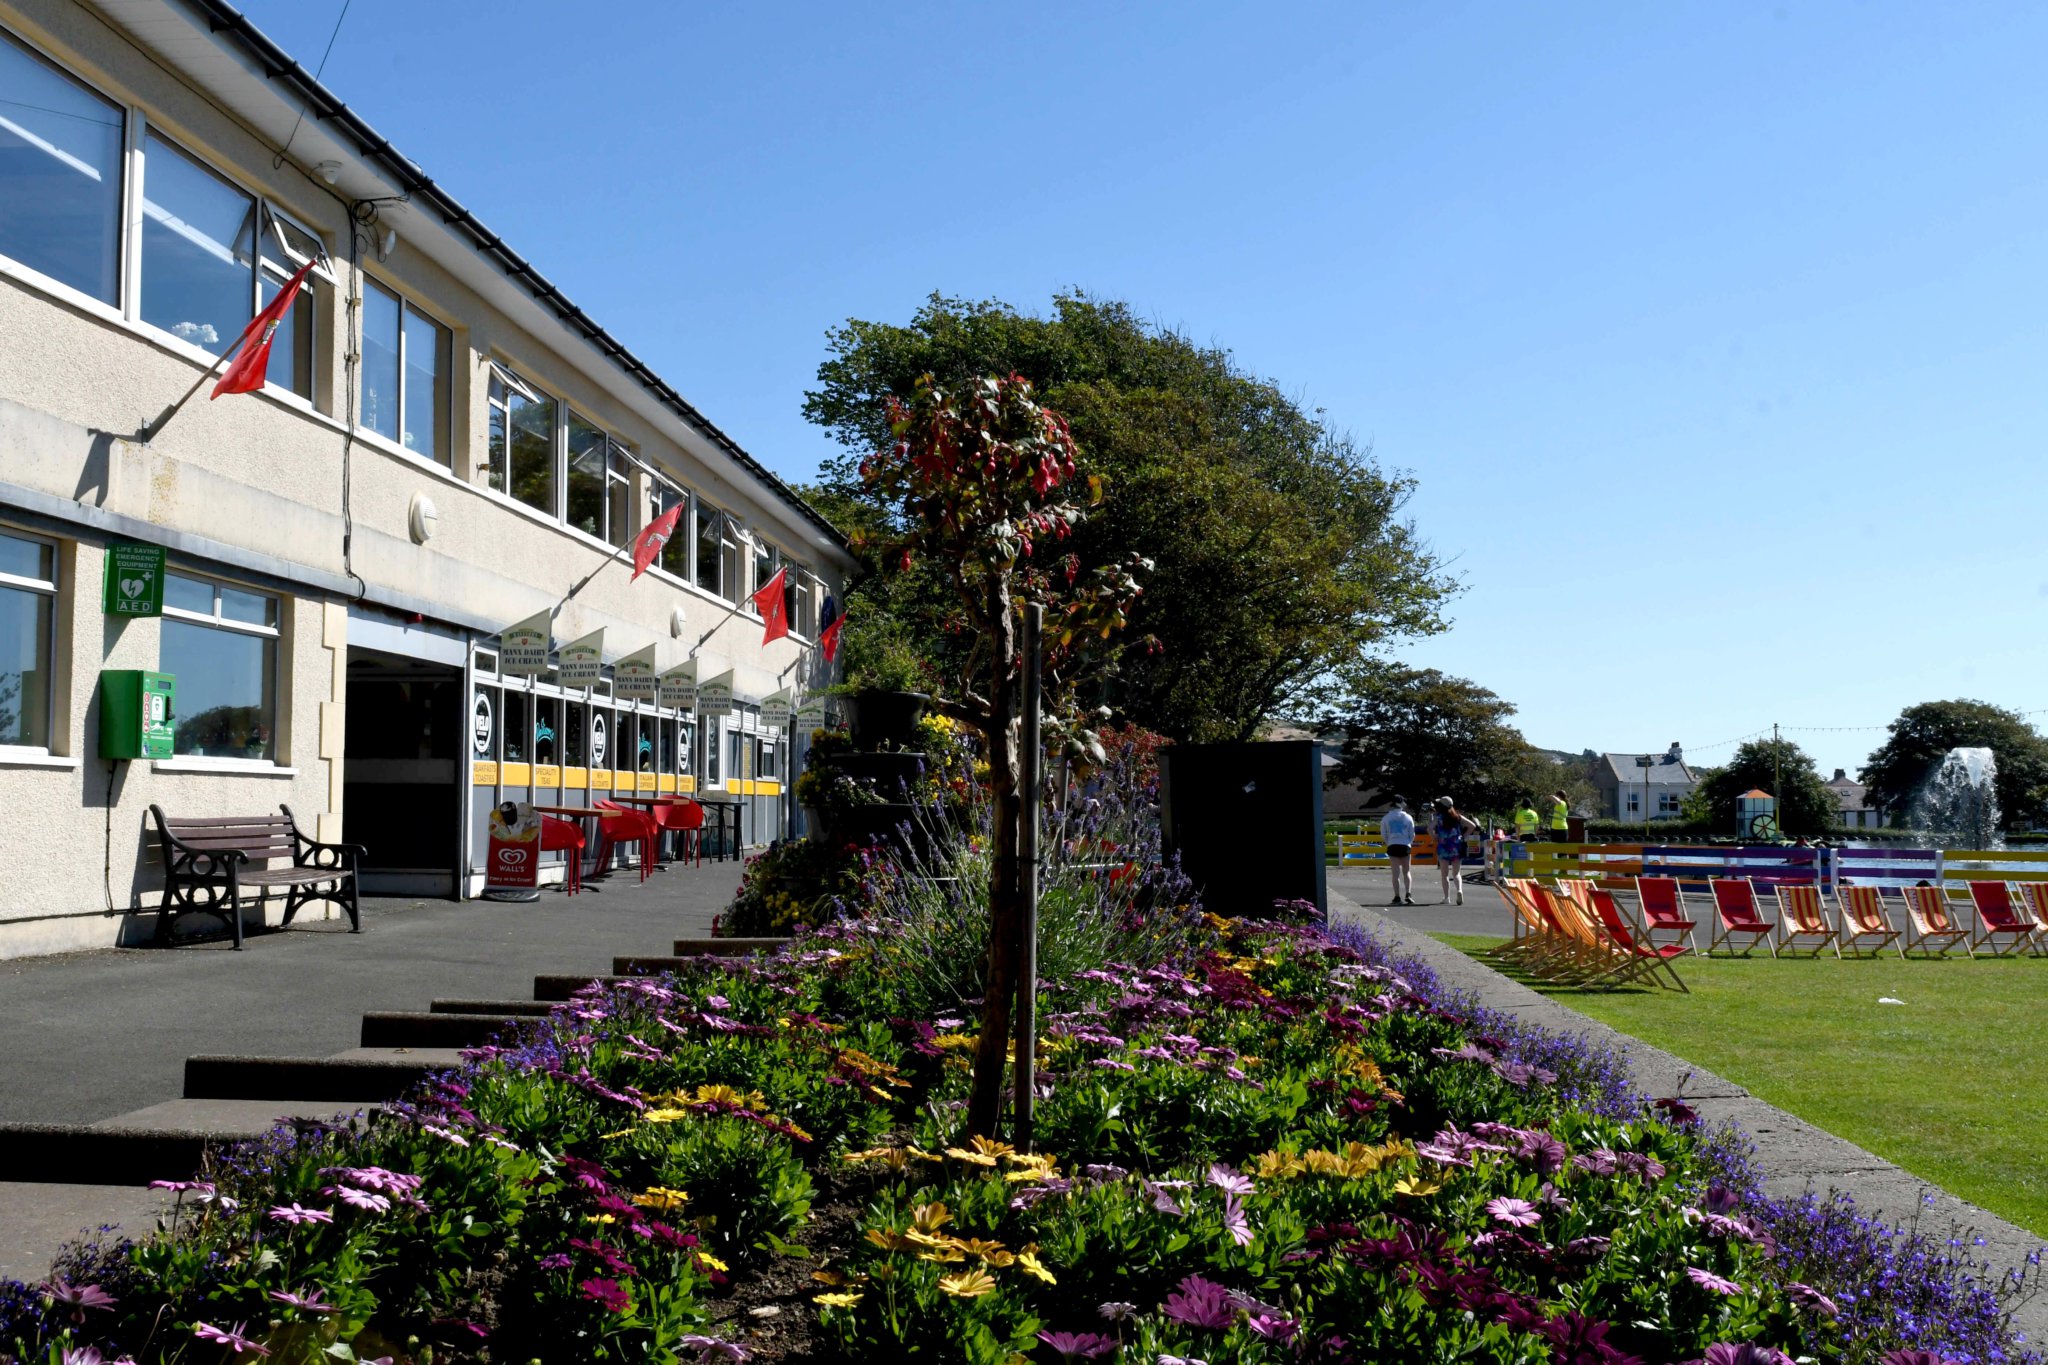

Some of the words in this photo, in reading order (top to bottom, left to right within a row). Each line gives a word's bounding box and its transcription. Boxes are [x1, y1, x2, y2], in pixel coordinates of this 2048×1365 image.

[116, 554, 160, 562] EMERGENCY
[117, 561, 157, 569] EQUIPMENT
[505, 657, 517, 665] ICE
[518, 657, 543, 665] CREAM
[474, 764, 496, 773] REAKFASTS
[499, 864, 525, 873] WALL'S
